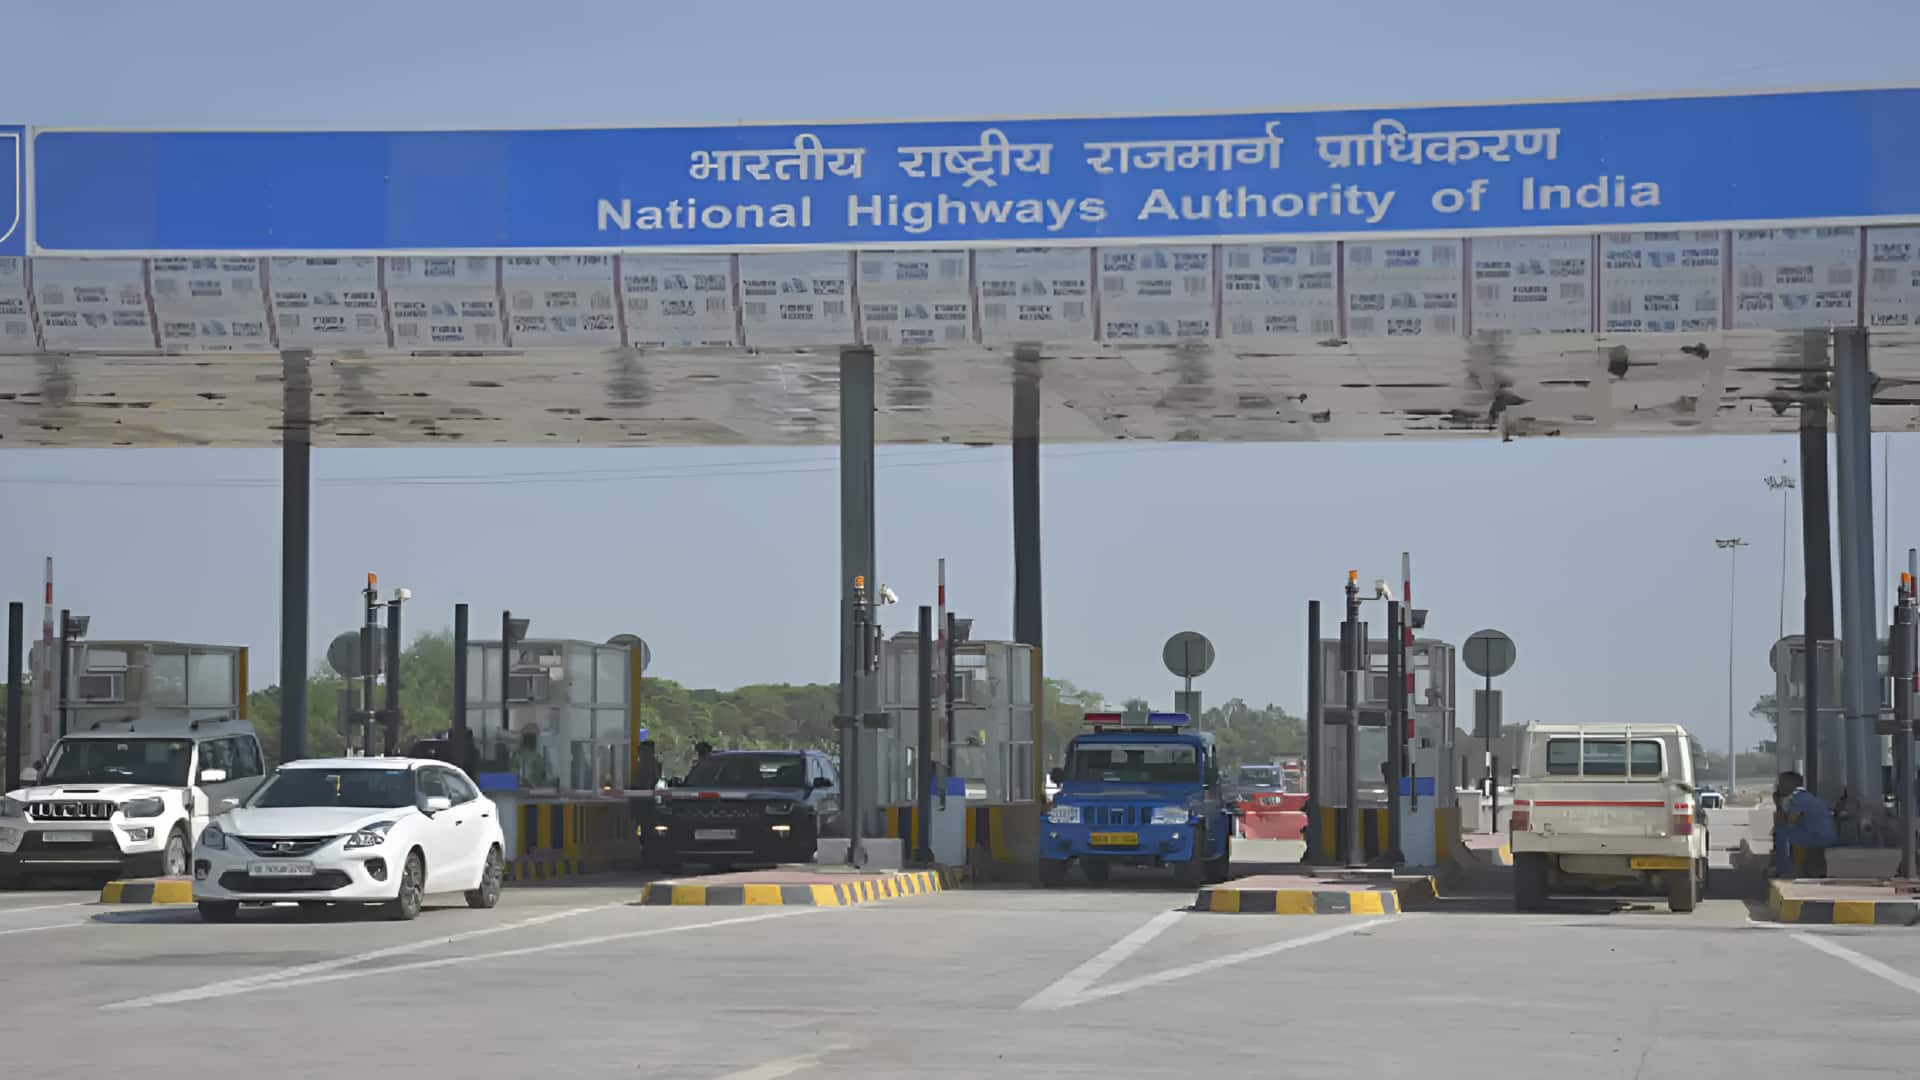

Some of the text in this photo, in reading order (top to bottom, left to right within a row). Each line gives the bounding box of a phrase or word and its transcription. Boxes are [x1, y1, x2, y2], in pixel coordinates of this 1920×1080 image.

[689, 118, 1561, 188] भारतीय राष्ट्रीय राजमार्ग प्राधिकरण
[597, 175, 1661, 233] National Highways Authority of India
